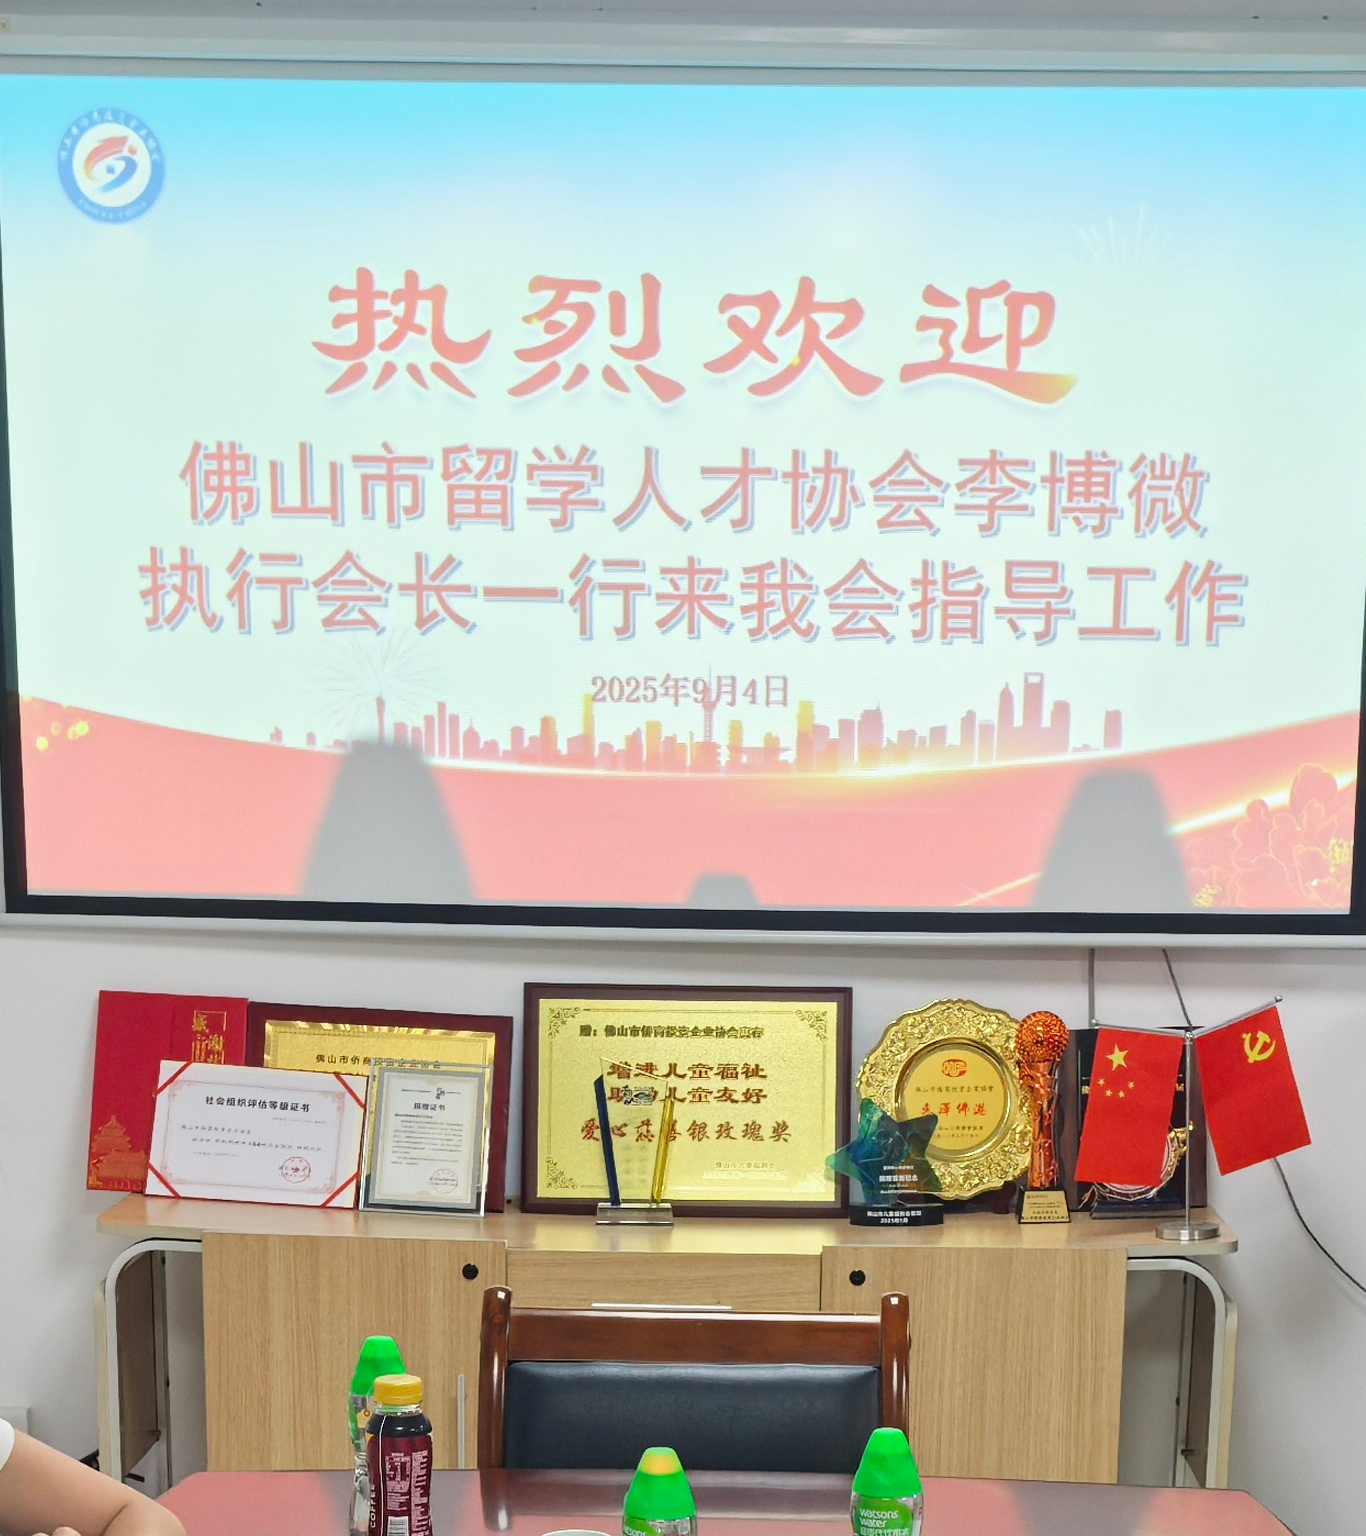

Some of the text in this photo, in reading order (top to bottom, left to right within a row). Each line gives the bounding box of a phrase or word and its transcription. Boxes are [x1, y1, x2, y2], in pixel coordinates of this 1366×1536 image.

[311, 265, 1079, 403] 热烈欢迎
[179, 440, 1210, 540] 佛山市留学人才协会李博微
[137, 545, 1249, 646] 执行会长一行来我会指导工作
[590, 673, 790, 710] 2025年9月4日
[205, 1095, 311, 1114] 社会组织评估等级证书
